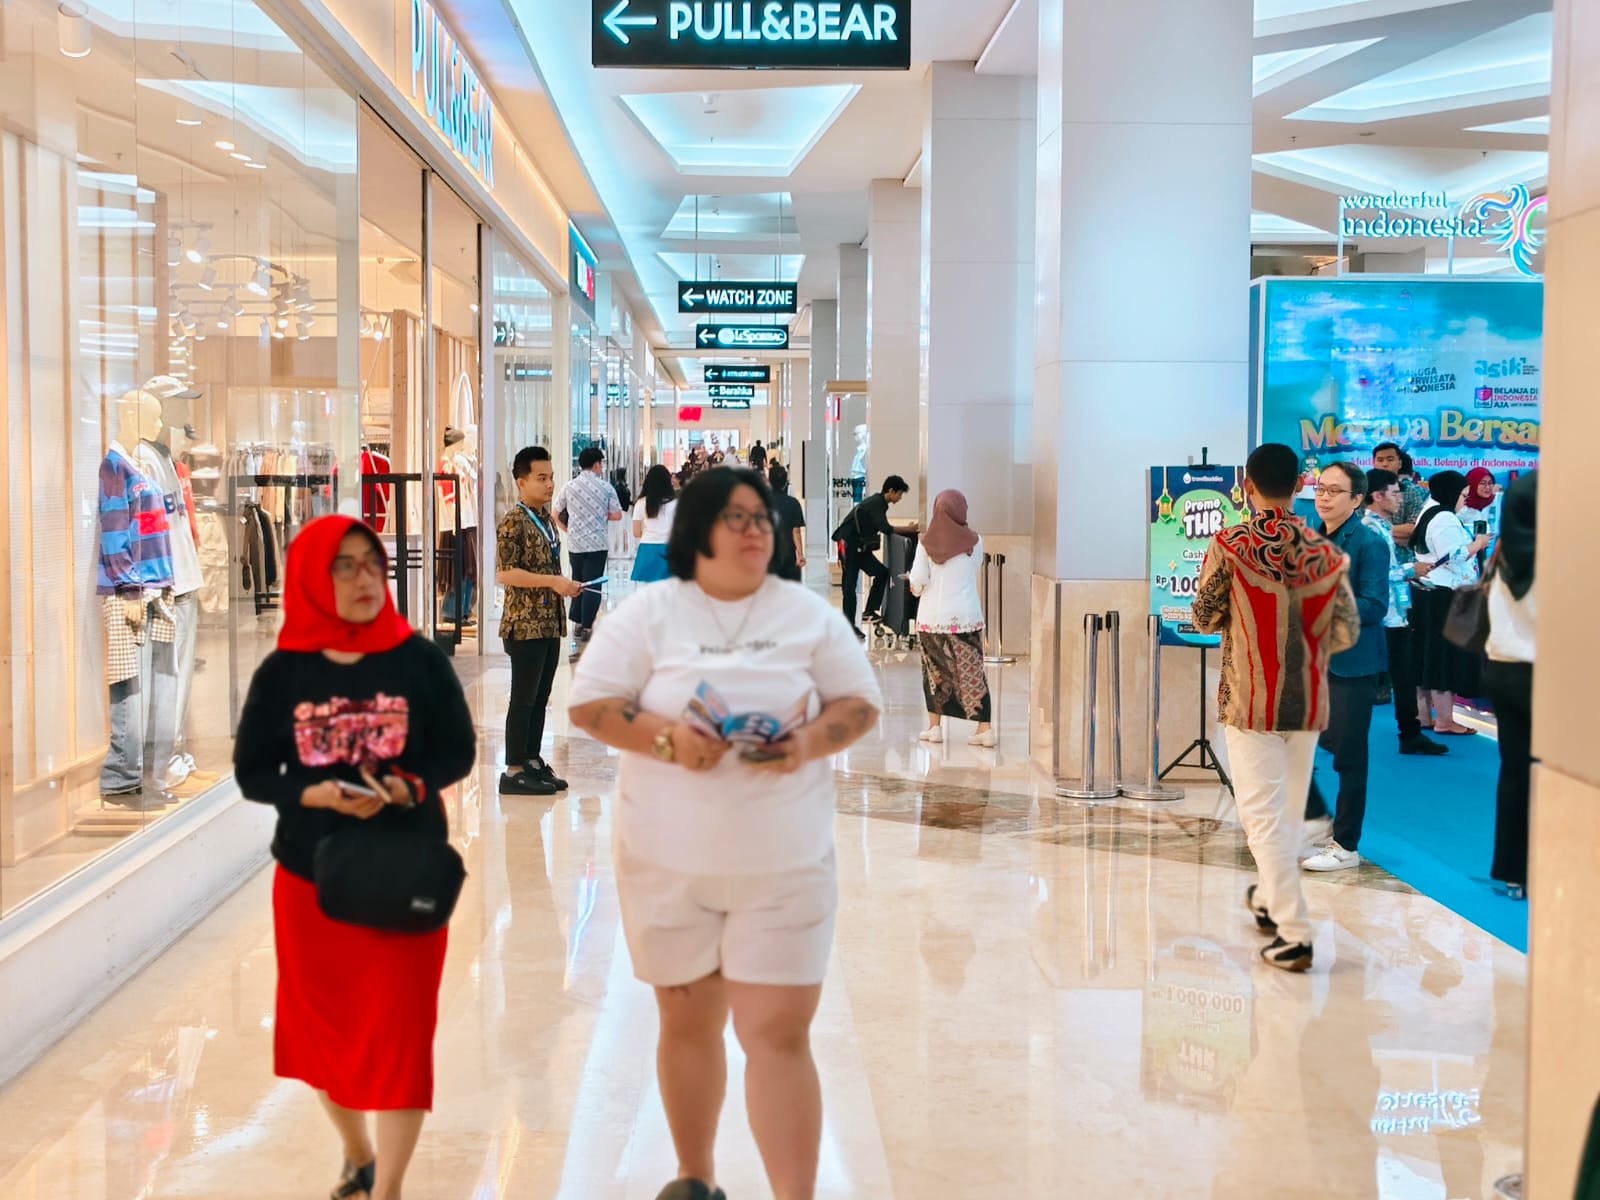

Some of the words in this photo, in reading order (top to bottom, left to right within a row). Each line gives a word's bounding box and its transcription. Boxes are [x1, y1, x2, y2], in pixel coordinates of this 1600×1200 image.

[669, 1, 899, 41] PULL&BEAR
[1339, 190, 1448, 209] wonderful
[1341, 210, 1486, 238] indonesia
[706, 289, 755, 305] WATCH
[757, 289, 793, 305] ZONE
[1494, 387, 1529, 395] BELANJA
[1494, 394, 1538, 402] INDONESIA
[1184, 499, 1221, 513] Promo
[1183, 510, 1222, 537] THR
[1156, 575, 1167, 584] Rp
